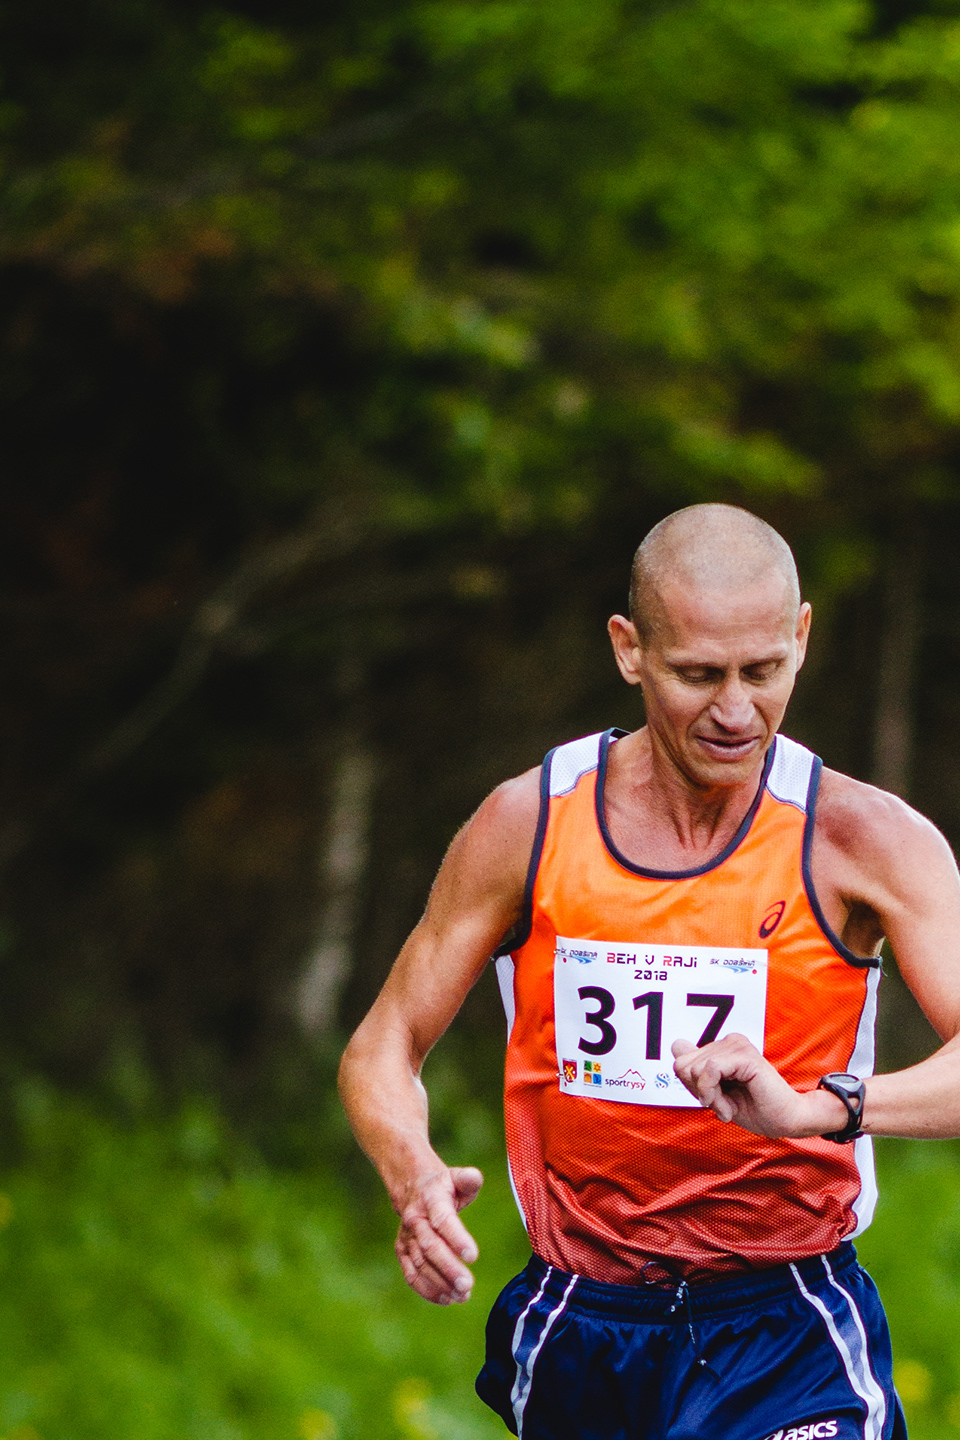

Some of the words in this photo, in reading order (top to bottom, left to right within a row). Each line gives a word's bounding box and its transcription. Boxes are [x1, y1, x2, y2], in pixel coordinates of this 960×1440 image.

[606, 952, 636, 965] BEH
[634, 969, 668, 981] 2018
[577, 985, 735, 1061] 317
[605, 1077, 646, 1090] sportrysy
